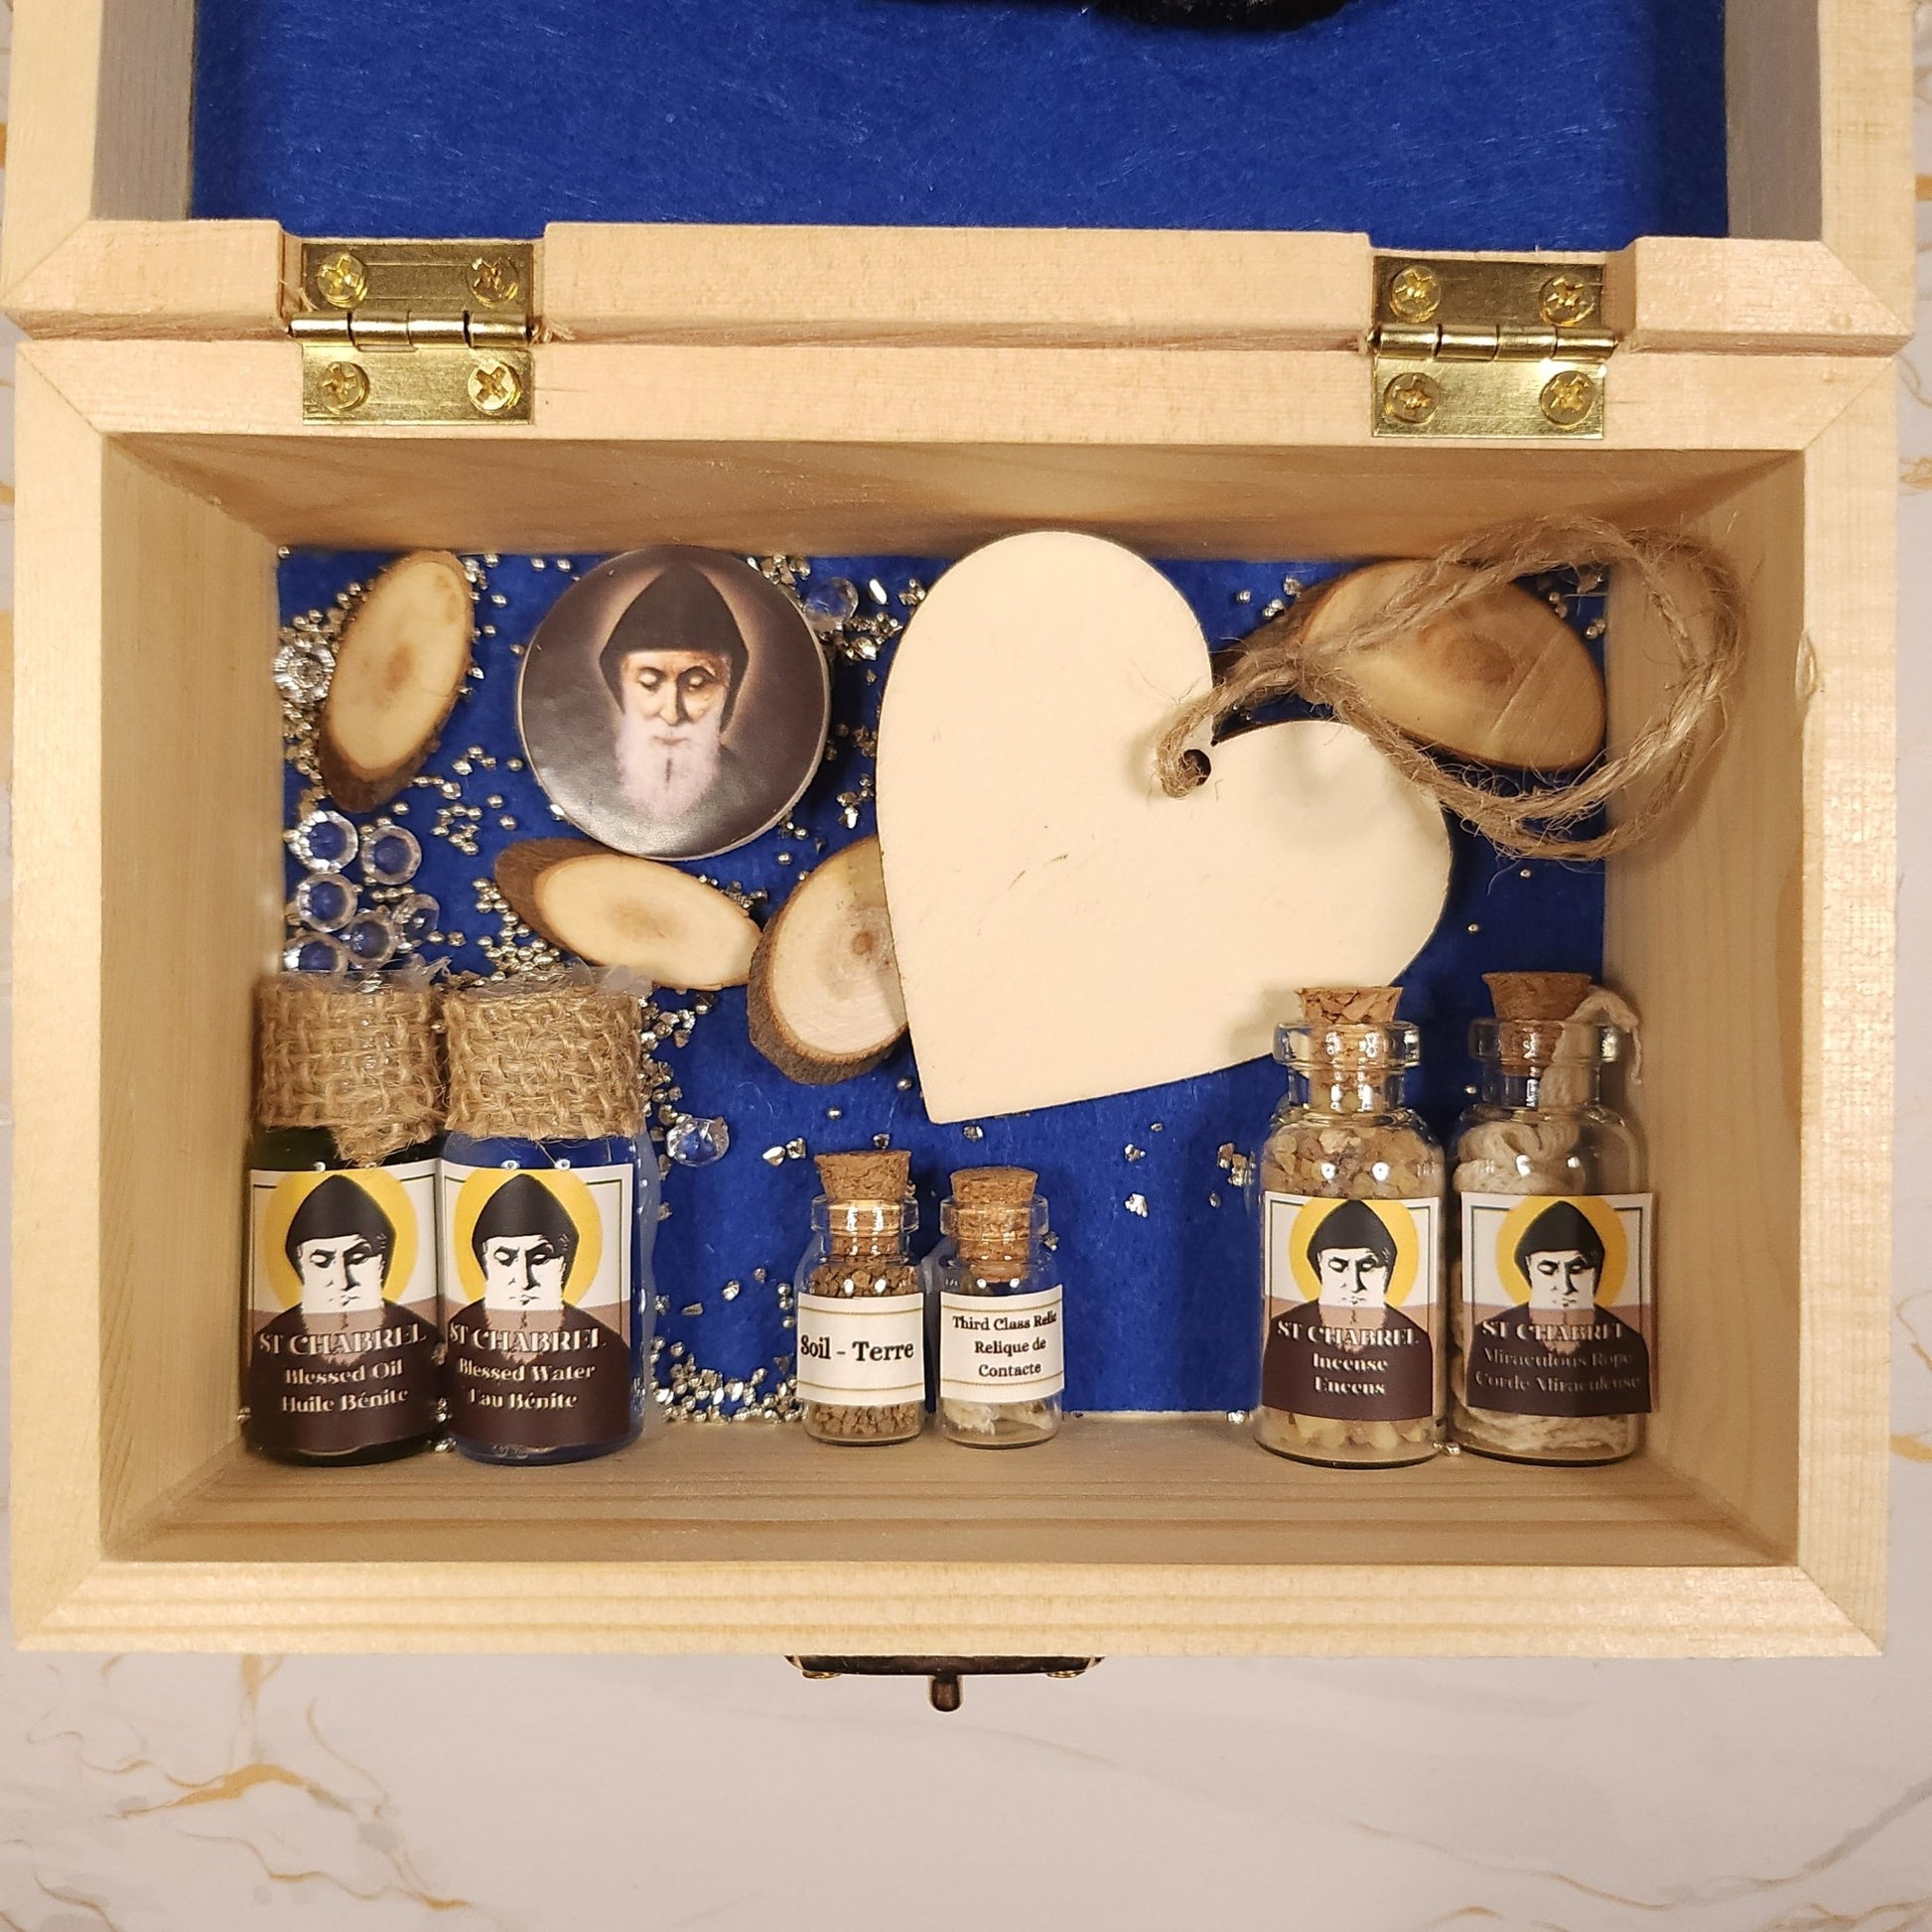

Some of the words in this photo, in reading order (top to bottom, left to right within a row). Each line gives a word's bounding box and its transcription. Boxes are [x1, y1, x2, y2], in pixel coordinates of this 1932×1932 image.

[952, 1315, 990, 1330] Third
[993, 1317, 1031, 1331] Class
[1034, 1310, 1057, 1328] Relic
[1278, 1319, 1304, 1341] ST
[1481, 1320, 1509, 1339] ST
[260, 1331, 283, 1354] ST
[450, 1321, 469, 1344] ST
[800, 1334, 831, 1360] Soil
[852, 1340, 914, 1362] Terre
[974, 1338, 1029, 1357] Relique
[1033, 1337, 1046, 1351] de
[459, 1357, 525, 1381] Blessed
[531, 1364, 596, 1382] Water
[978, 1361, 1041, 1377] Contacte
[1312, 1353, 1388, 1372] Incense
[1591, 1351, 1633, 1369] Rope
[286, 1364, 365, 1385] Blessed
[372, 1358, 403, 1379] Oil
[1475, 1371, 1530, 1391] Corde
[1314, 1376, 1386, 1395] Encens
[282, 1394, 335, 1414] Huile
[341, 1388, 409, 1412] Bénite
[509, 1392, 578, 1411] Bénite
